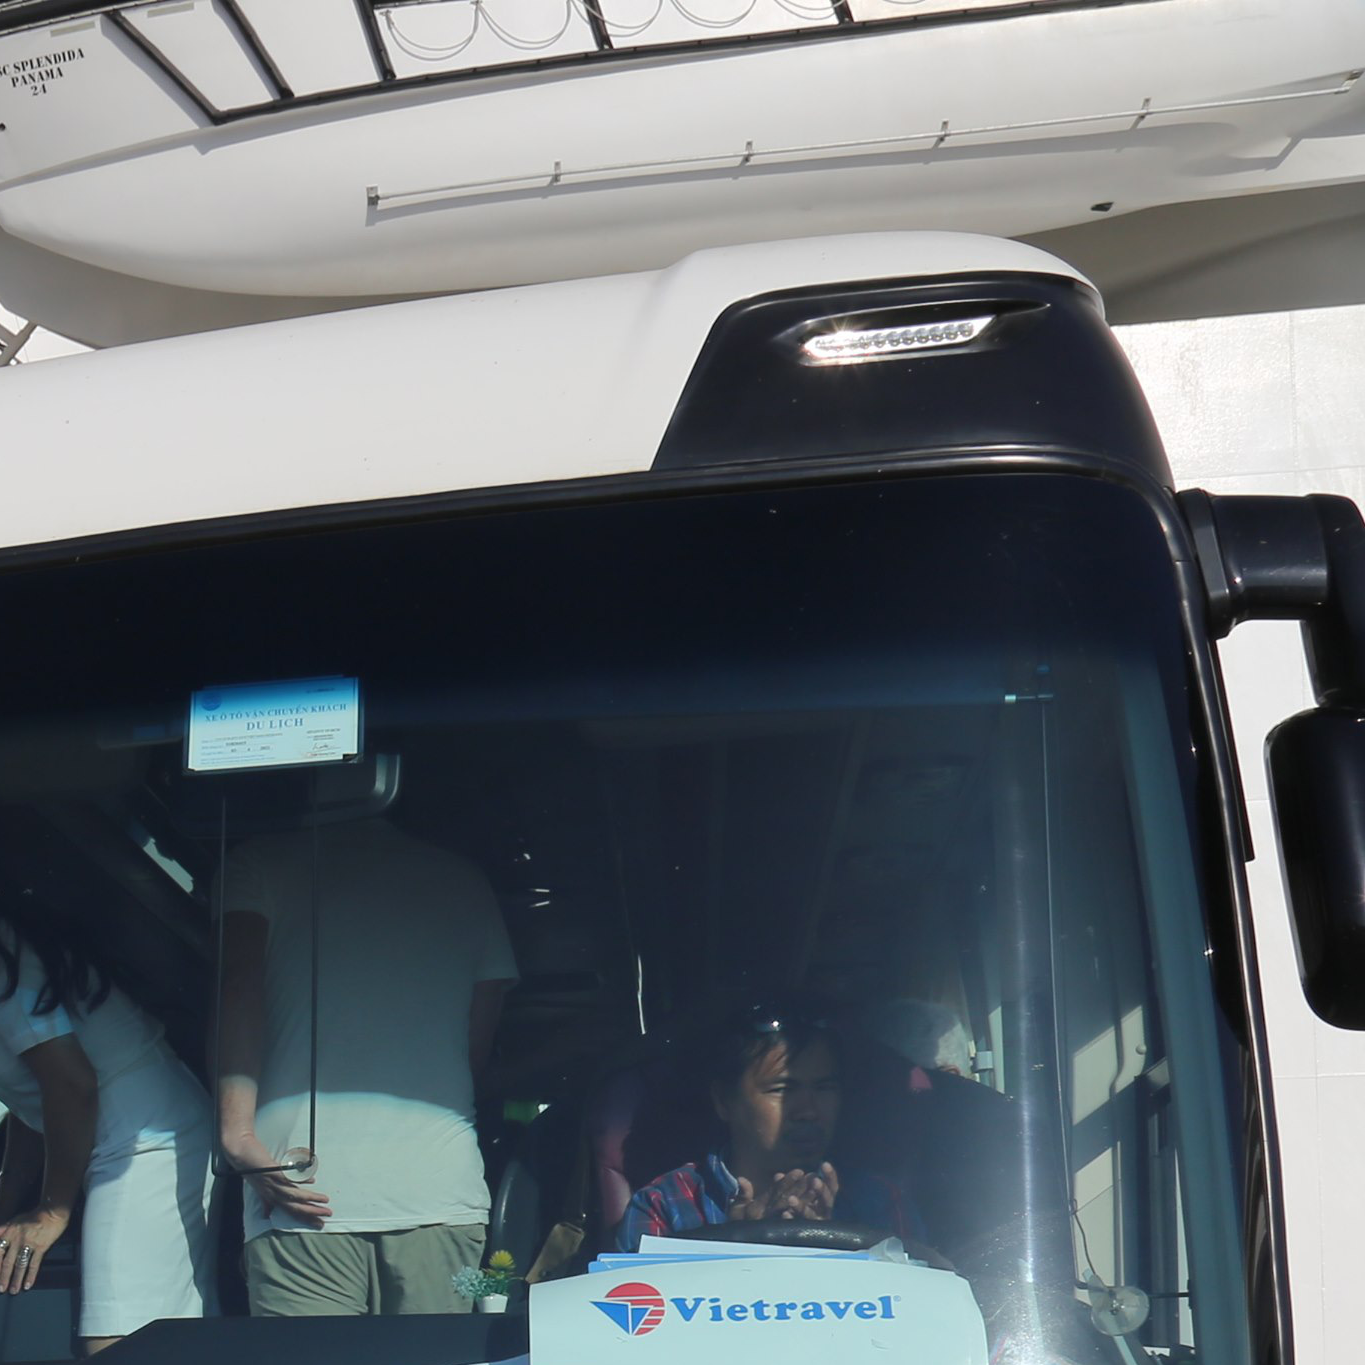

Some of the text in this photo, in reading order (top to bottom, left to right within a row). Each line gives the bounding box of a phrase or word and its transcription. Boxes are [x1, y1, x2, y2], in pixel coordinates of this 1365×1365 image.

[13, 48, 85, 73] SPLENDIDA
[11, 67, 63, 88] PANAMA
[30, 83, 47, 96] 24
[246, 721, 266, 731] DU
[669, 1295, 896, 1323] Vietravel
